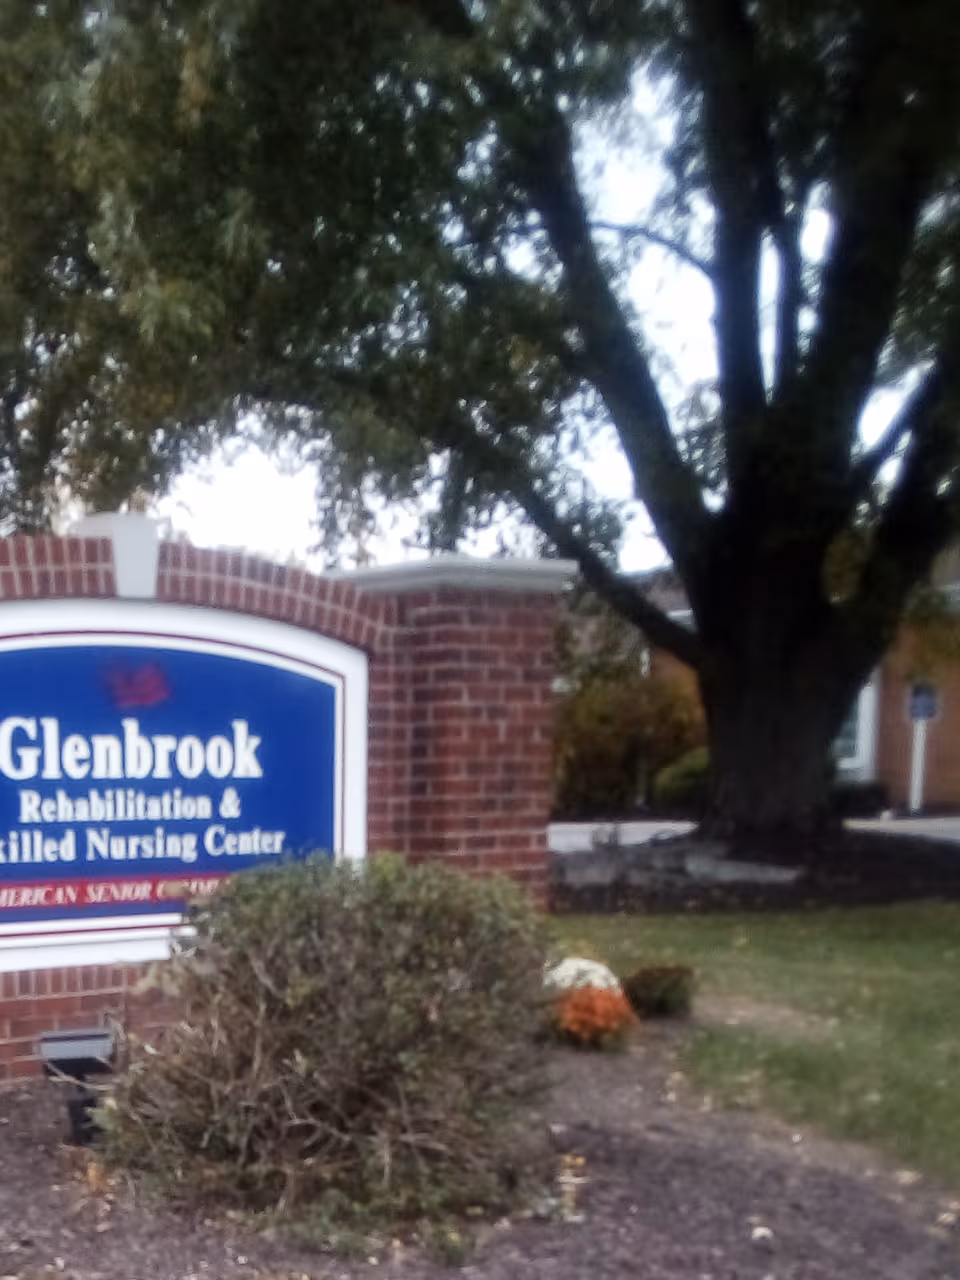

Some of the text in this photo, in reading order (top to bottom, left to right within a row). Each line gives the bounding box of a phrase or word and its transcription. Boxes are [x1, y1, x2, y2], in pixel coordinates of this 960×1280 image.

[20, 788, 241, 823] Rehabilitation &
[87, 827, 197, 863] Nursing
[204, 825, 285, 855] Center
[85, 881, 153, 903] SENIOR
